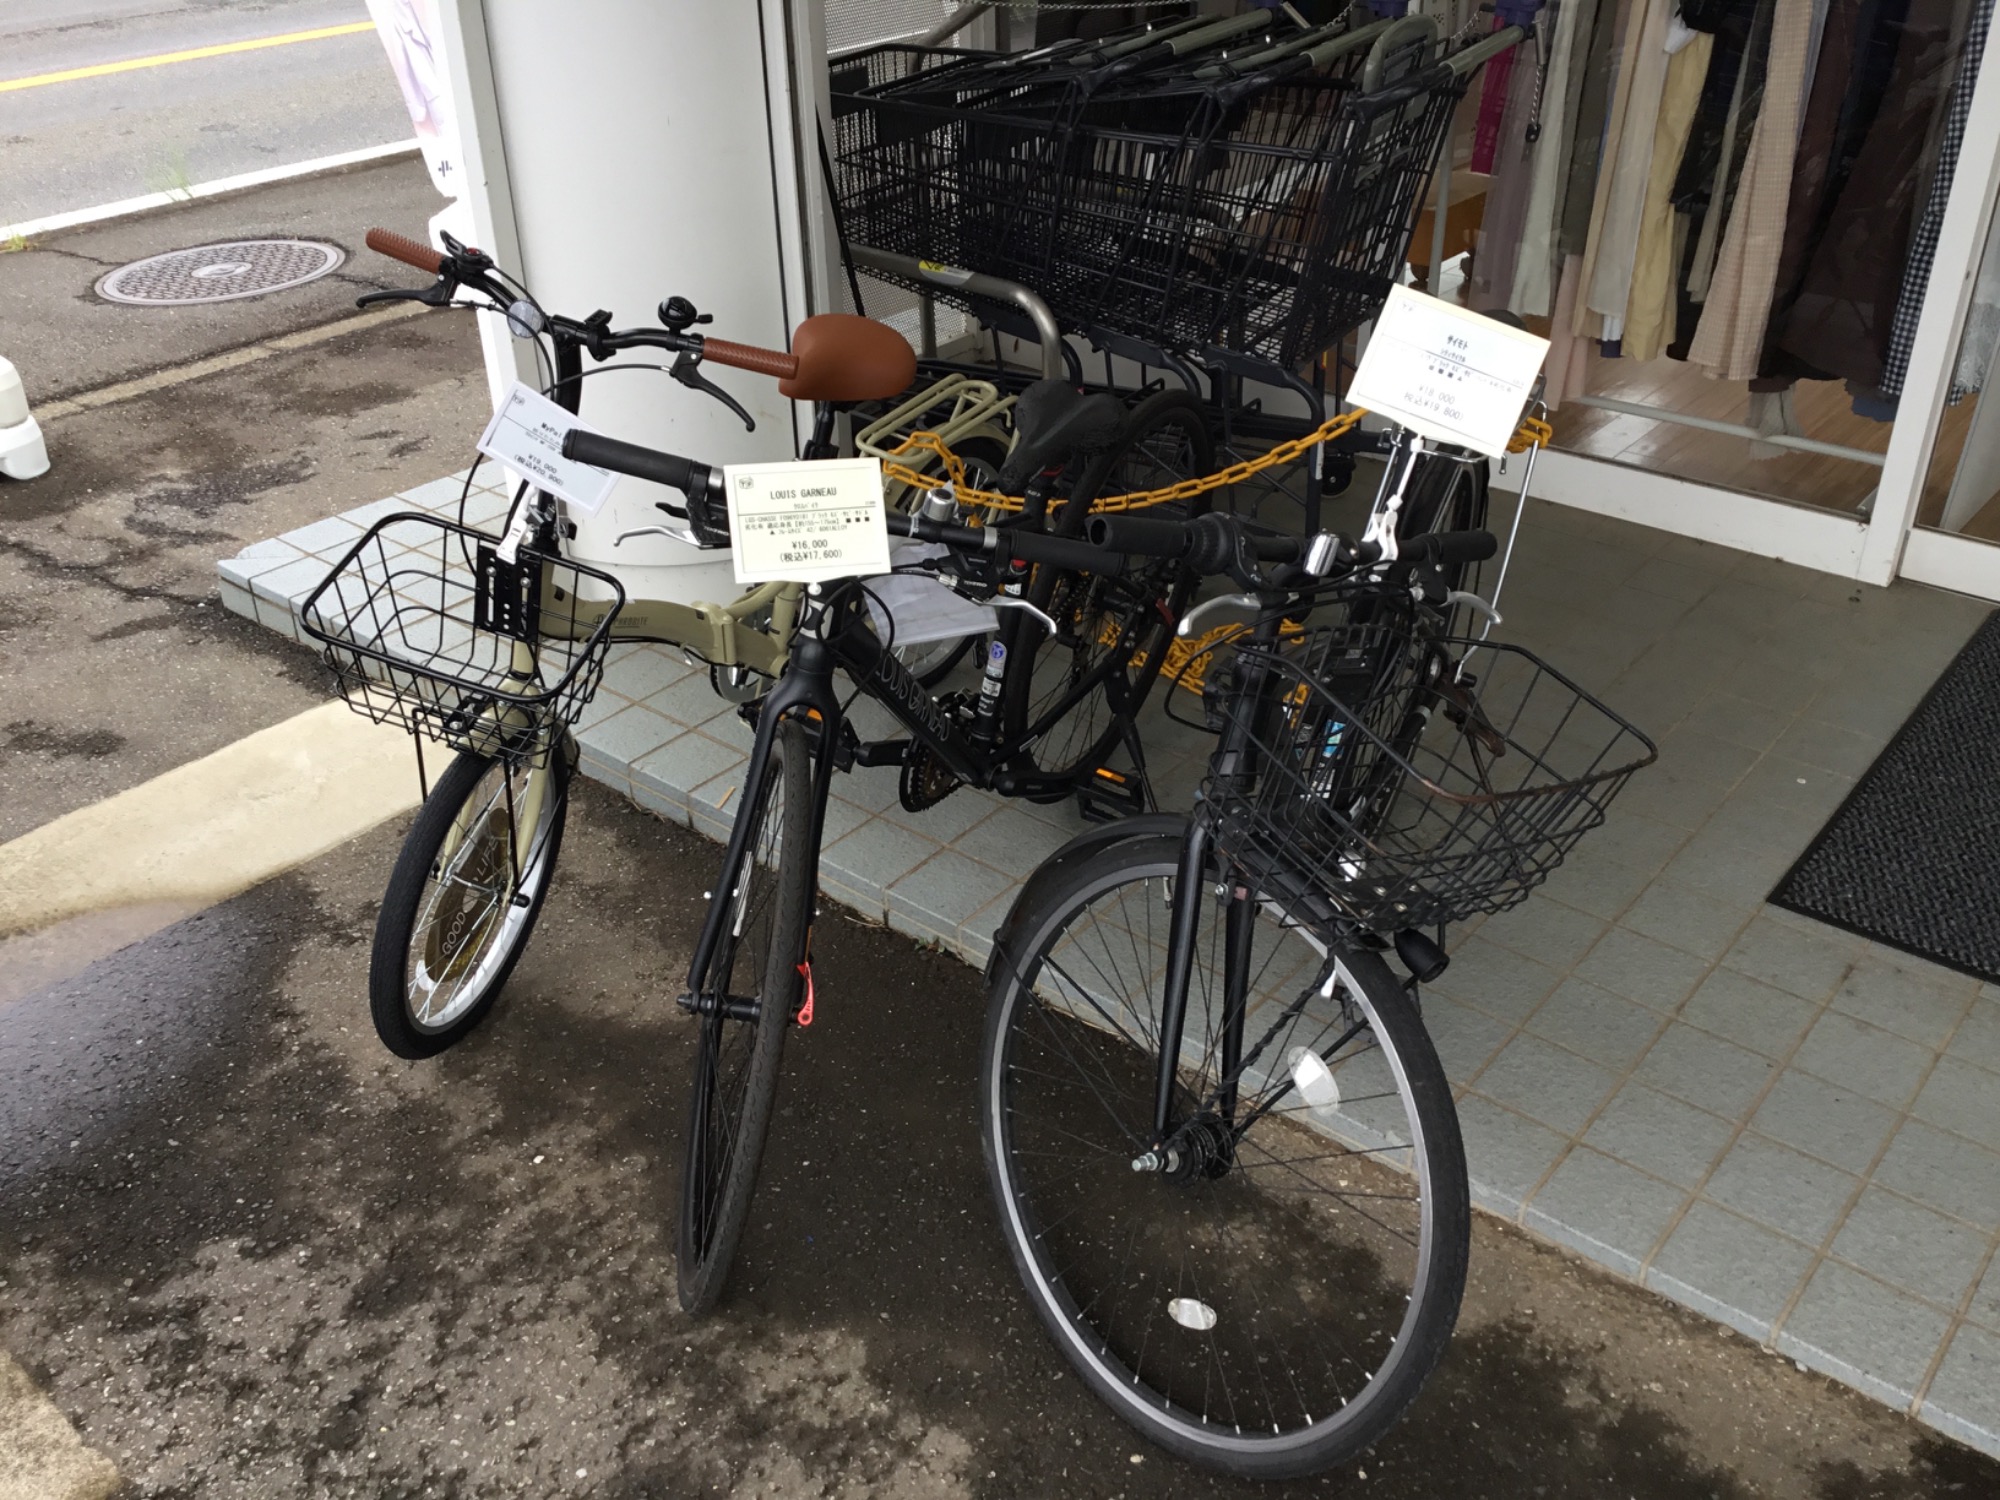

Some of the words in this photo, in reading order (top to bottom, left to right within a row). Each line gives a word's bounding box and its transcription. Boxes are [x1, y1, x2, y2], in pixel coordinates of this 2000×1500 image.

[541, 422, 562, 438] MyPal
[770, 489, 797, 500] LOUIS
[800, 487, 837, 498] GARNEAU
[792, 539, 828, 550] ¥16,000
[779, 549, 843, 563] (税込¥17,600)
[877, 652, 911, 700] OUIS
[442, 911, 467, 956] GOOD
[476, 839, 499, 877] LIFE
